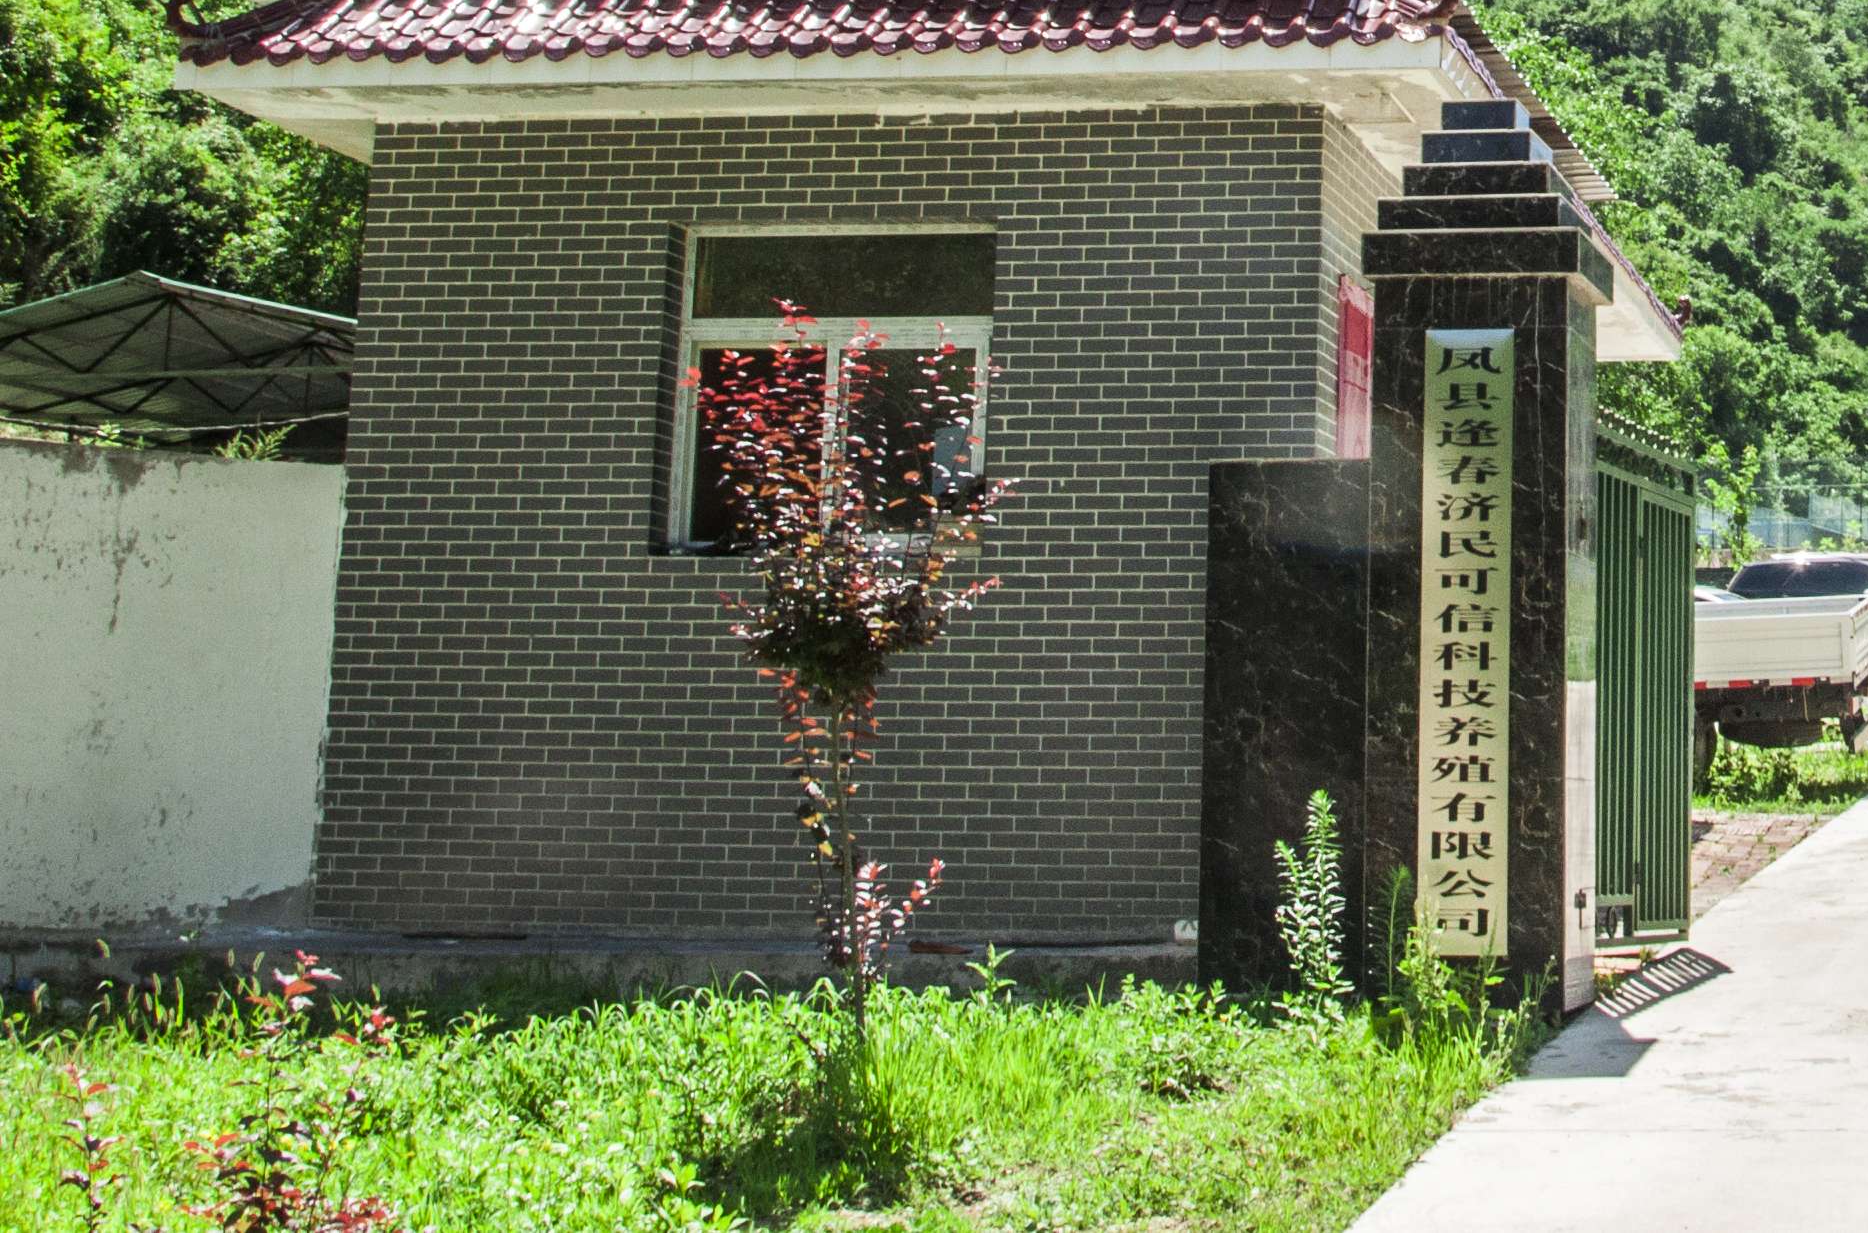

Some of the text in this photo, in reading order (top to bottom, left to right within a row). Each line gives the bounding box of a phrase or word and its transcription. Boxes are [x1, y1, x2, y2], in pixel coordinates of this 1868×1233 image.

[1430, 346, 1503, 938] 凤县逢春济民可信科技养殖有限公司
